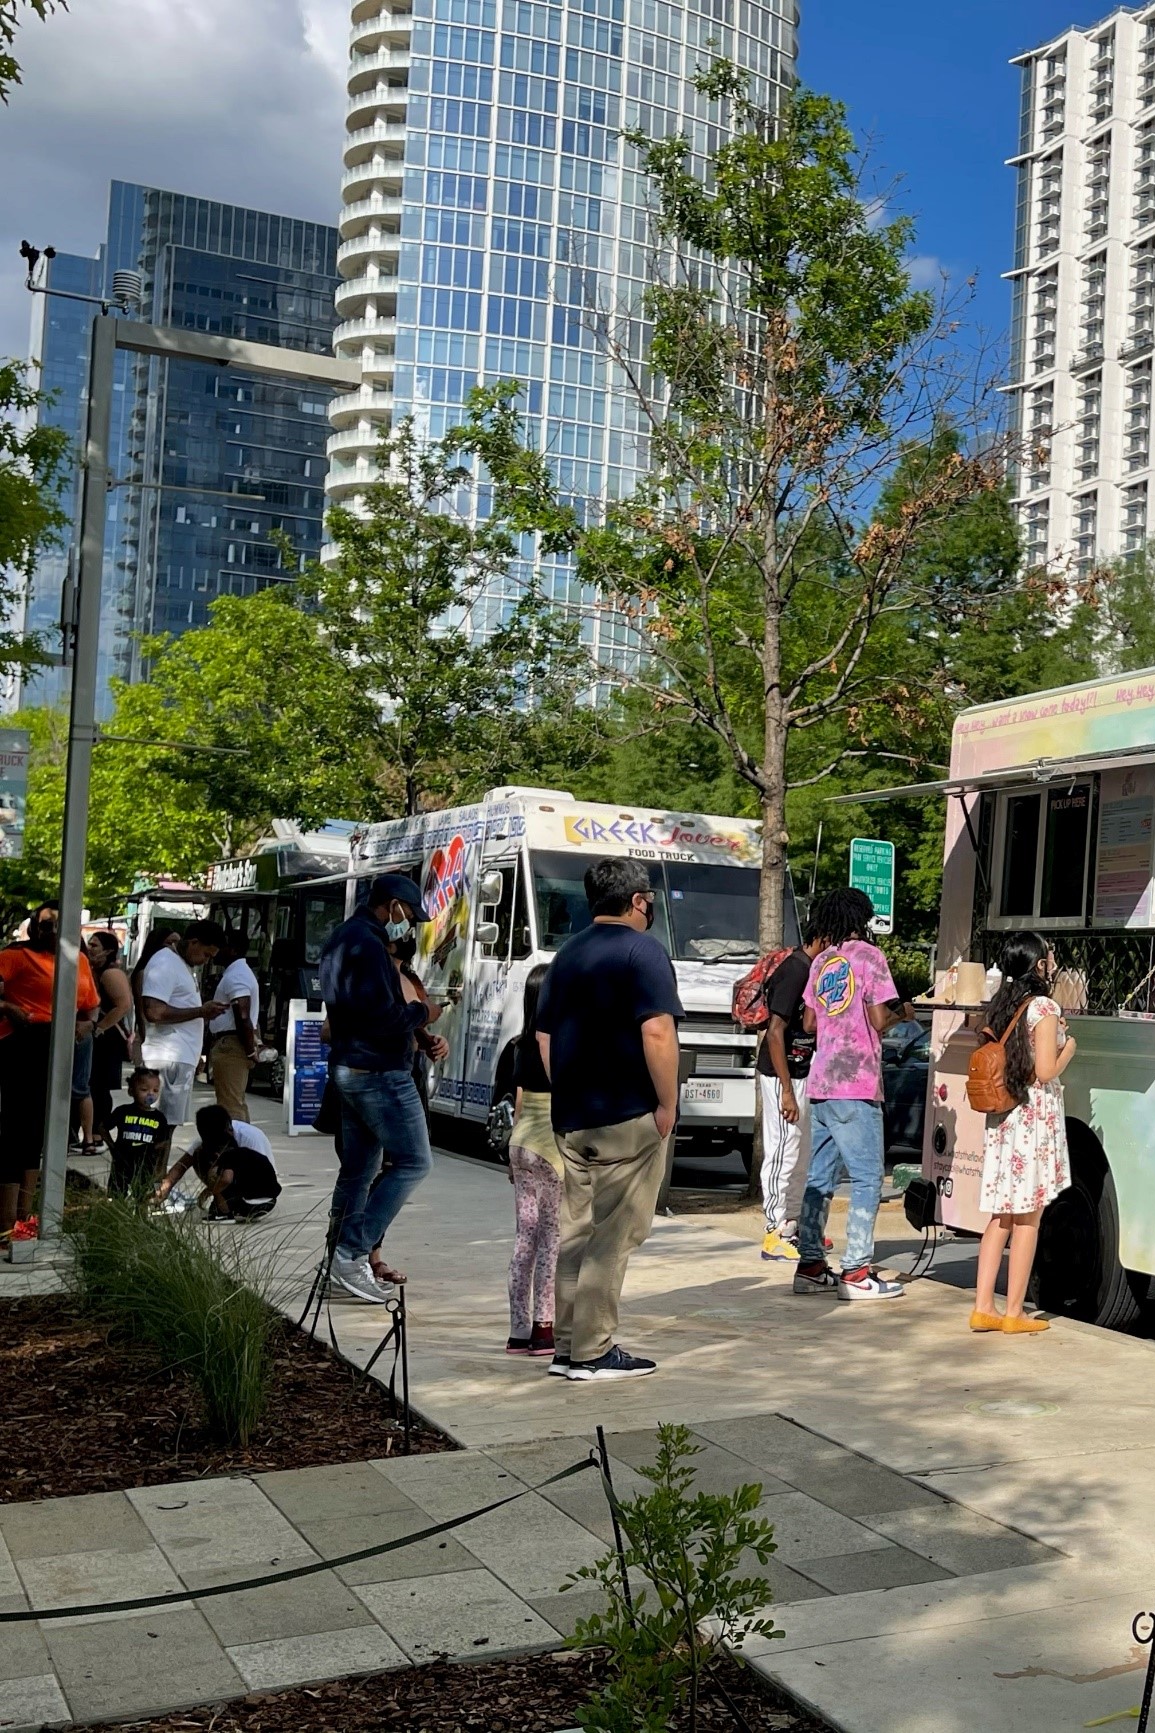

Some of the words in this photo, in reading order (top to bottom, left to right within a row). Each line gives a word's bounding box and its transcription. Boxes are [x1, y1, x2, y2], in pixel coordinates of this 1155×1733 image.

[0, 755, 24, 766] RUCK
[573, 818, 657, 844] GREEK
[628, 848, 655, 858] FOOD
[659, 851, 695, 862] TRUCK
[125, 1115, 138, 1124] HIT
[139, 1116, 159, 1129] HARD
